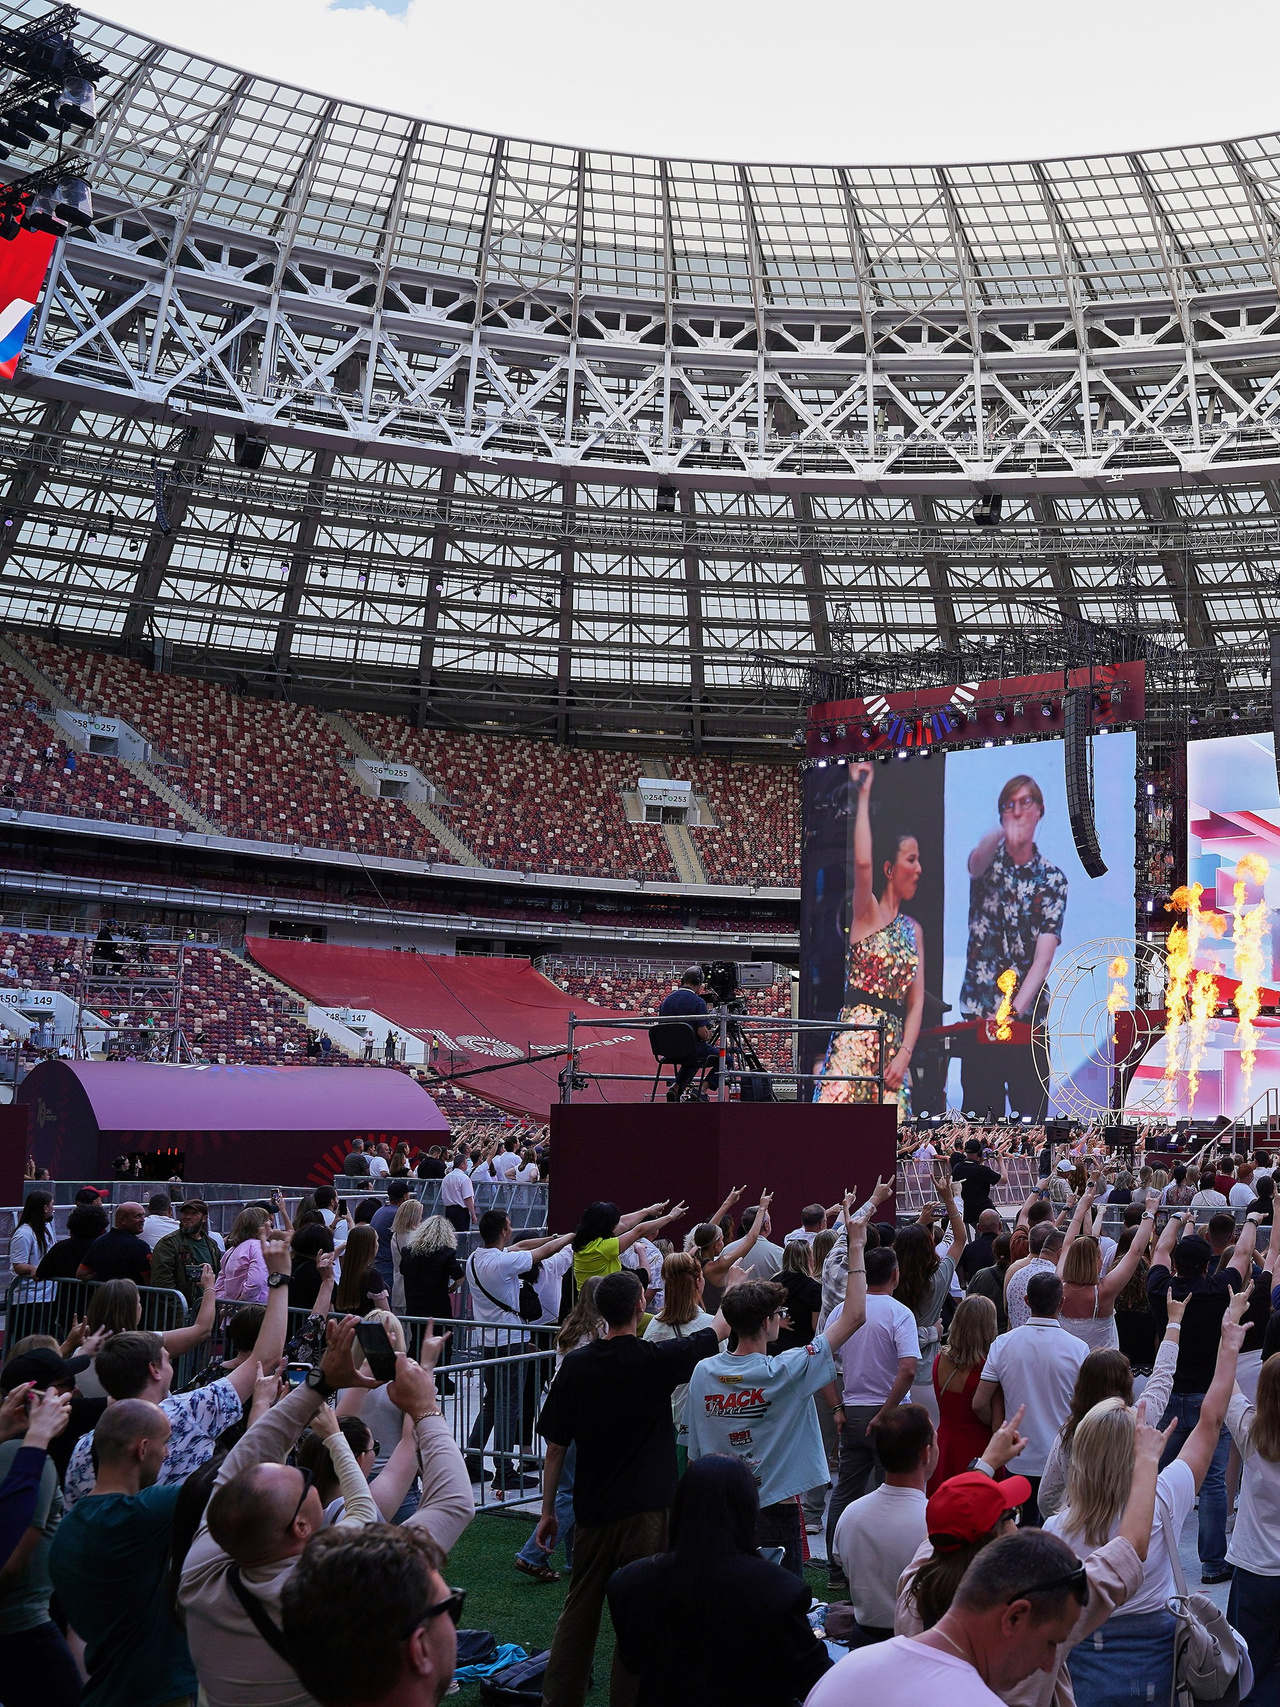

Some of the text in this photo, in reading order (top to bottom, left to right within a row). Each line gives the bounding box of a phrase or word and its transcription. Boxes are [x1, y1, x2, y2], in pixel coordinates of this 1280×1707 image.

[100, 723, 117, 733] 257
[394, 769, 408, 778] 255
[33, 996, 53, 1005] 149
[352, 1014, 367, 1022] 147
[704, 1387, 767, 1411] TRACK
[729, 1430, 751, 1441] 1991
